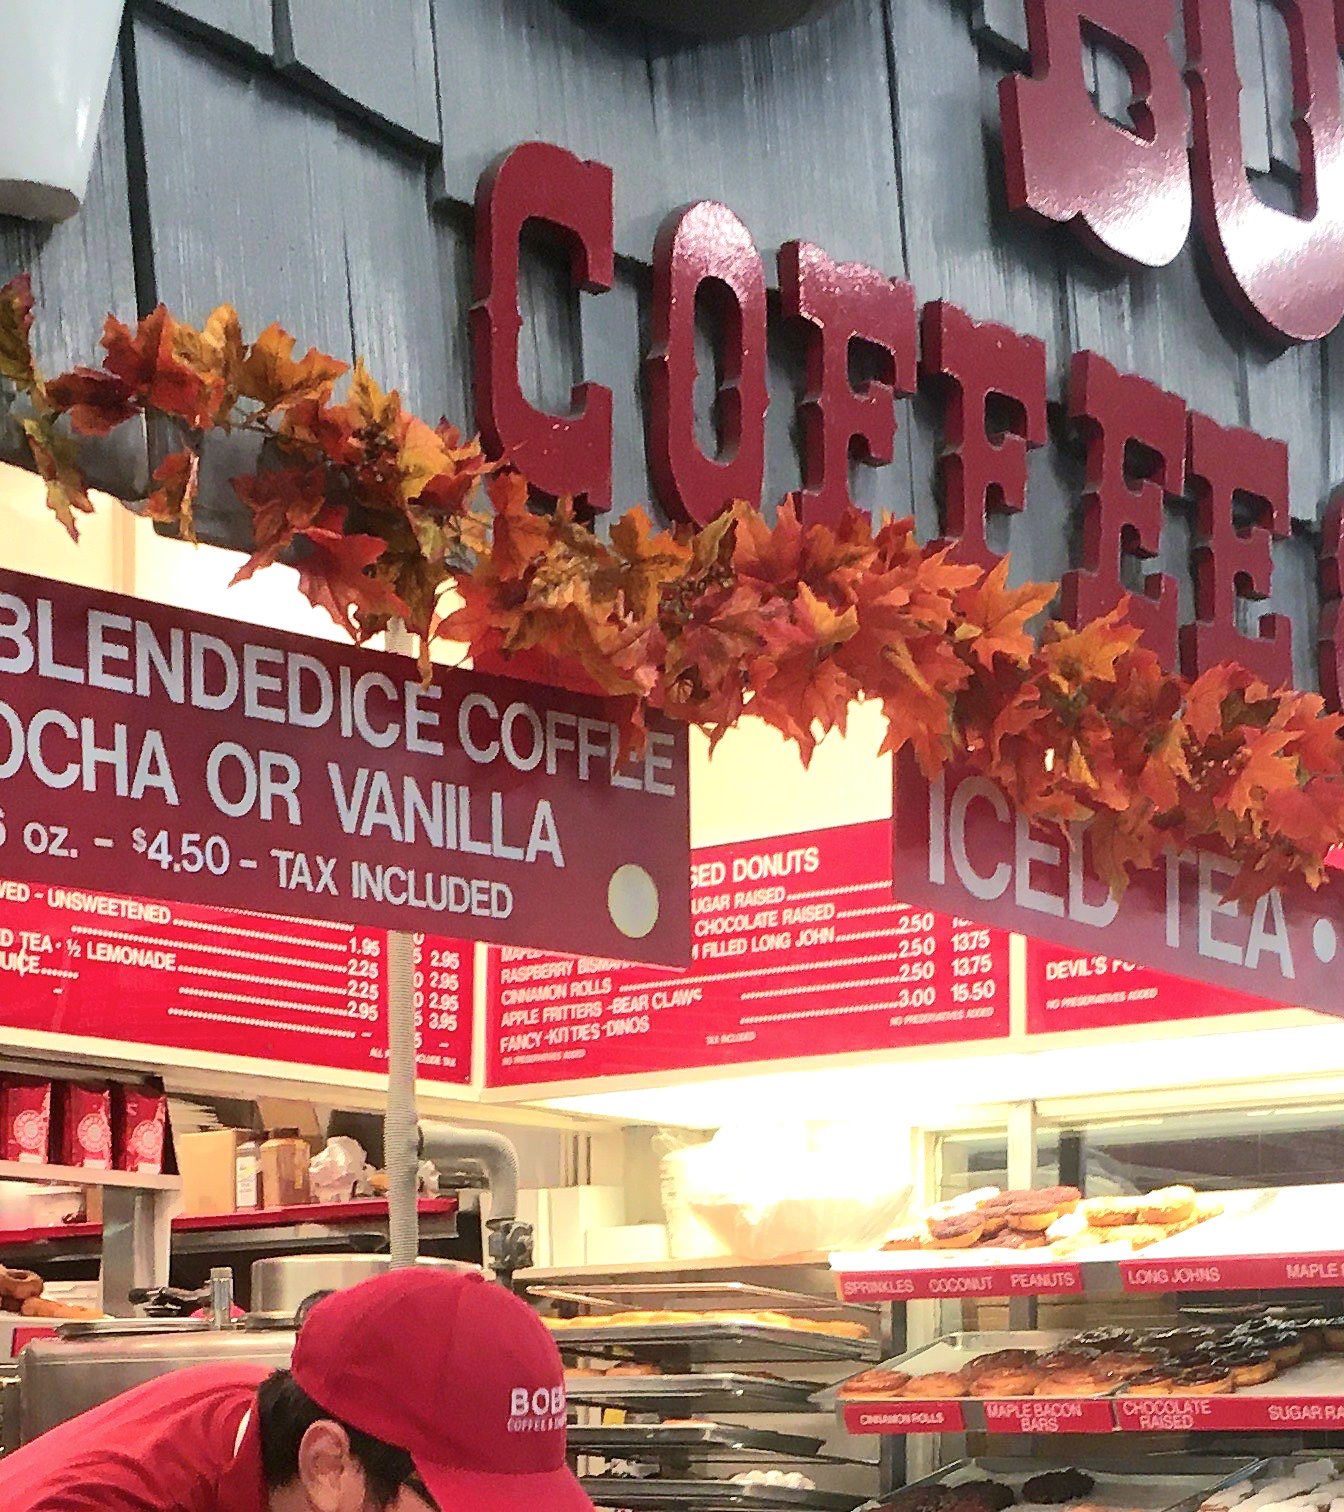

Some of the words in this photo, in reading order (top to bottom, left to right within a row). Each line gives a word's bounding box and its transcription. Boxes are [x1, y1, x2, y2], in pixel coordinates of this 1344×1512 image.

[471, 140, 1292, 700] COFFEE
[205, 740, 303, 826] OR
[327, 761, 566, 869] VANILLA
[131, 827, 230, 876] $4.50
[269, 848, 341, 897] TAX
[350, 861, 515, 921] INCLUDED
[731, 846, 821, 883] DONUTS
[927, 774, 1120, 929] ICED
[1162, 845, 1297, 981] TEA
[47, 886, 172, 926] UNSWEETENED
[733, 885, 787, 910] RAISED
[693, 909, 779, 938] CHOCOLATE
[781, 902, 836, 927] RAISED
[20, 931, 54, 955] TEA
[86, 940, 177, 973] LEMONADE
[702, 937, 748, 960] FILLED
[751, 931, 792, 954] LONG
[794, 926, 836, 949] JOHN
[499, 959, 575, 985] RASPBERRY
[1045, 954, 1109, 981] DEVIL'S
[500, 982, 568, 1008] CINNAMON
[569, 977, 613, 999] ROLLS
[950, 979, 996, 1003] 15.50
[499, 1006, 541, 1028] APPLE
[542, 1000, 604, 1025] FRITTERS
[499, 1030, 544, 1055] FANCY
[927, 1275, 994, 1294] COCONUT
[1009, 1271, 1076, 1289] PEANUTS
[1126, 1269, 1168, 1286] LONG
[1168, 1266, 1222, 1285] JOHNS
[1285, 1262, 1339, 1282] MAPLE
[843, 1277, 915, 1297] SPRINKLES
[985, 1402, 1030, 1419] MAPLE
[1032, 1402, 1084, 1419] BACON
[1121, 1399, 1213, 1417] CHOCOLATE
[1266, 1404, 1323, 1422] SUGAR
[1020, 1417, 1060, 1432] BARS
[1139, 1414, 1195, 1430] RAISED
